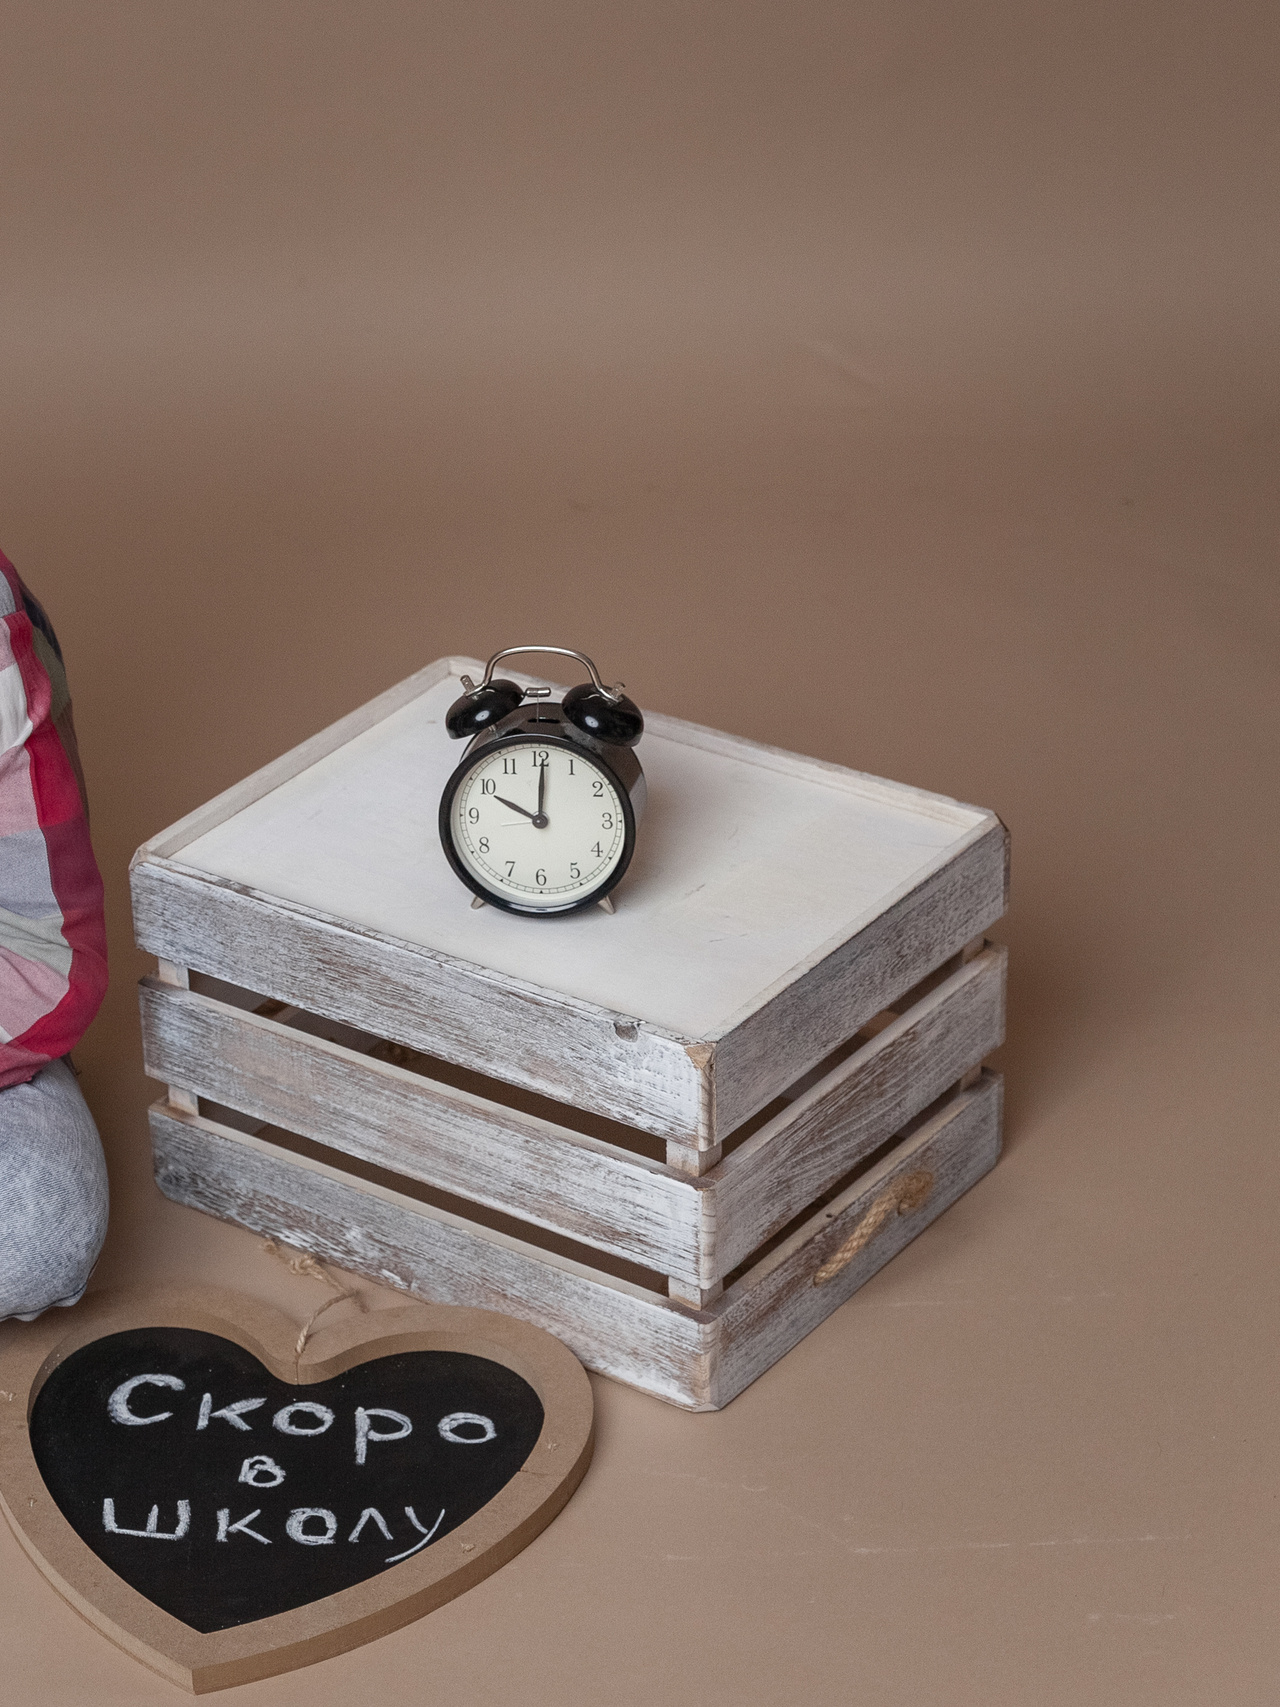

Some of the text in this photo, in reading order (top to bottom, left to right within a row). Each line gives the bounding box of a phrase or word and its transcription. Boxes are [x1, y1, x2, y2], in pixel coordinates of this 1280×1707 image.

[503, 759, 517, 774] 11
[532, 751, 549, 767] 12
[568, 759, 576, 775] 1
[480, 779, 495, 794] 10
[593, 782, 603, 797] 2
[469, 808, 479, 824] 9
[602, 813, 613, 829] 3
[479, 837, 489, 853] 8
[591, 841, 603, 857] 4
[505, 861, 515, 877] 7
[536, 869, 547, 885] 6
[570, 863, 580, 878] 5
[107, 1373, 498, 1465] Скоро
